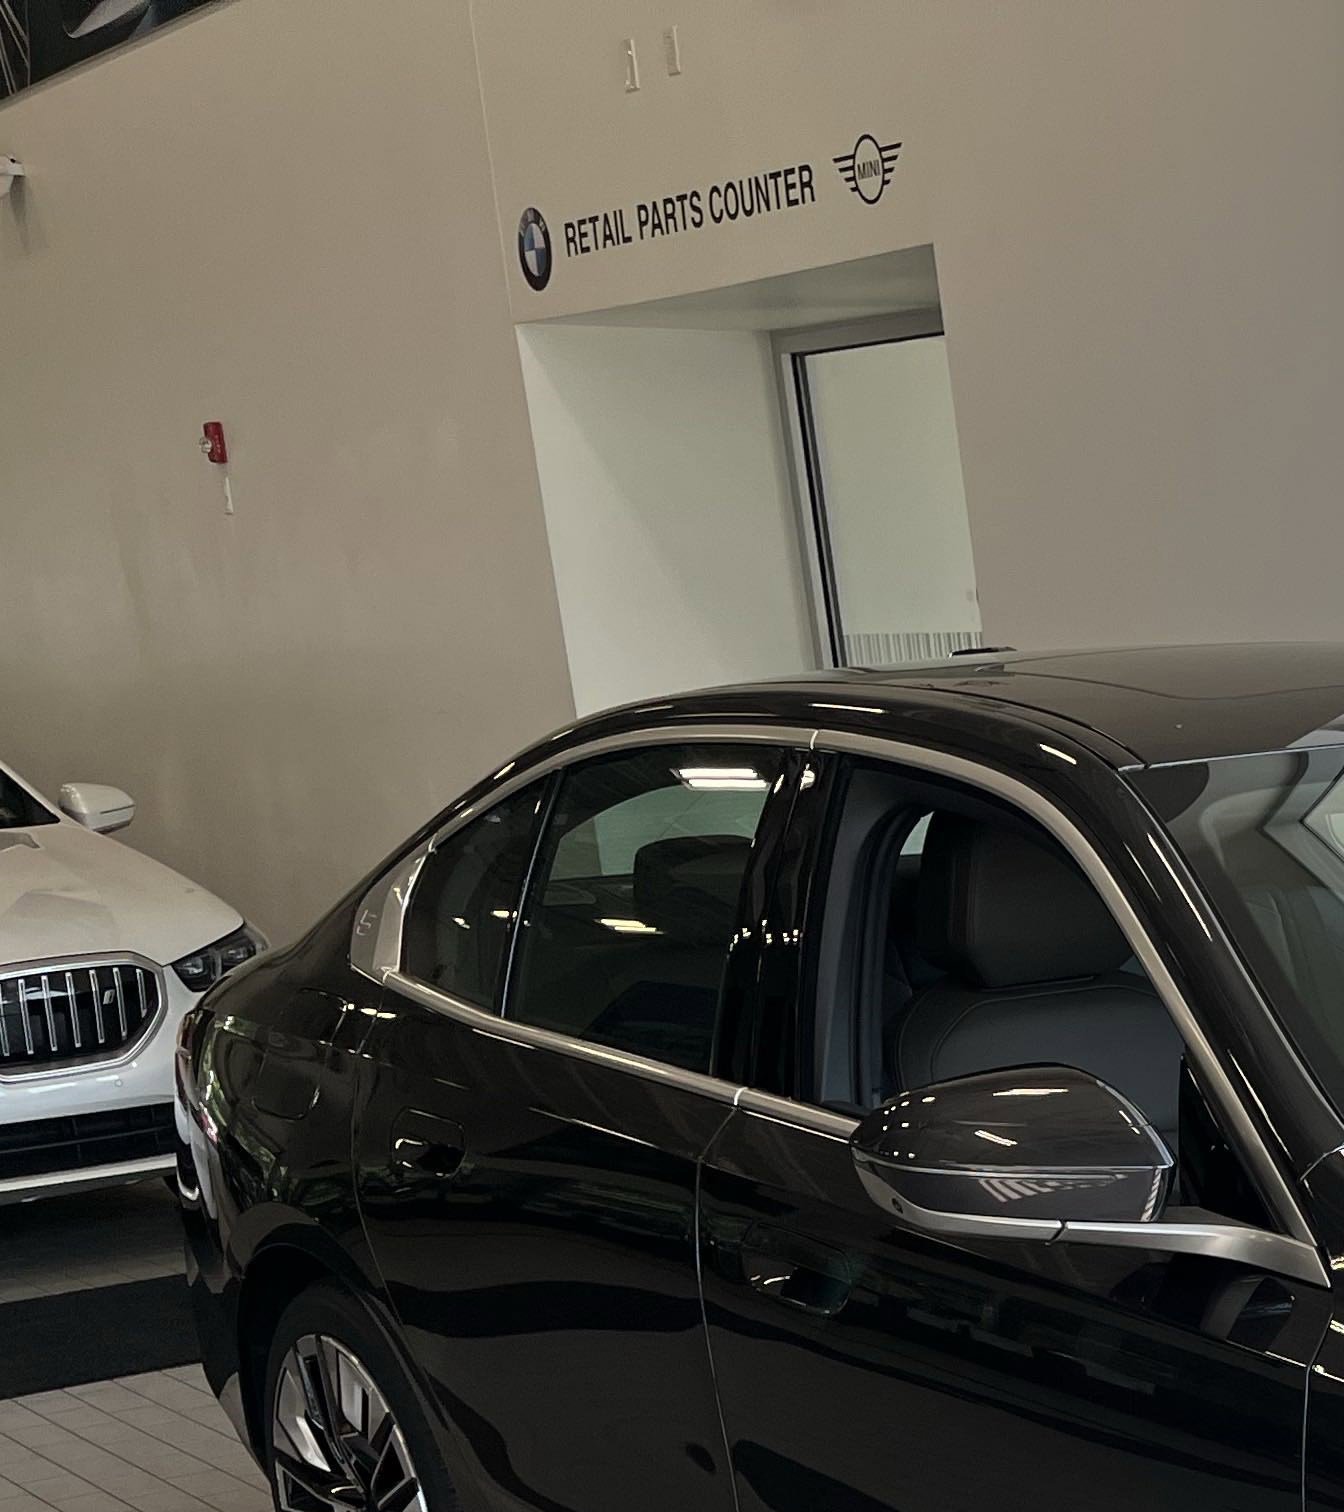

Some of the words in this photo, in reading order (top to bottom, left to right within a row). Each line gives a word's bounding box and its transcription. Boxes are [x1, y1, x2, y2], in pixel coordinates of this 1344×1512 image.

[857, 159, 882, 180] MINI
[563, 209, 632, 257] RETAIL
[636, 190, 704, 240] PARTS
[709, 164, 816, 224] COUNTER
